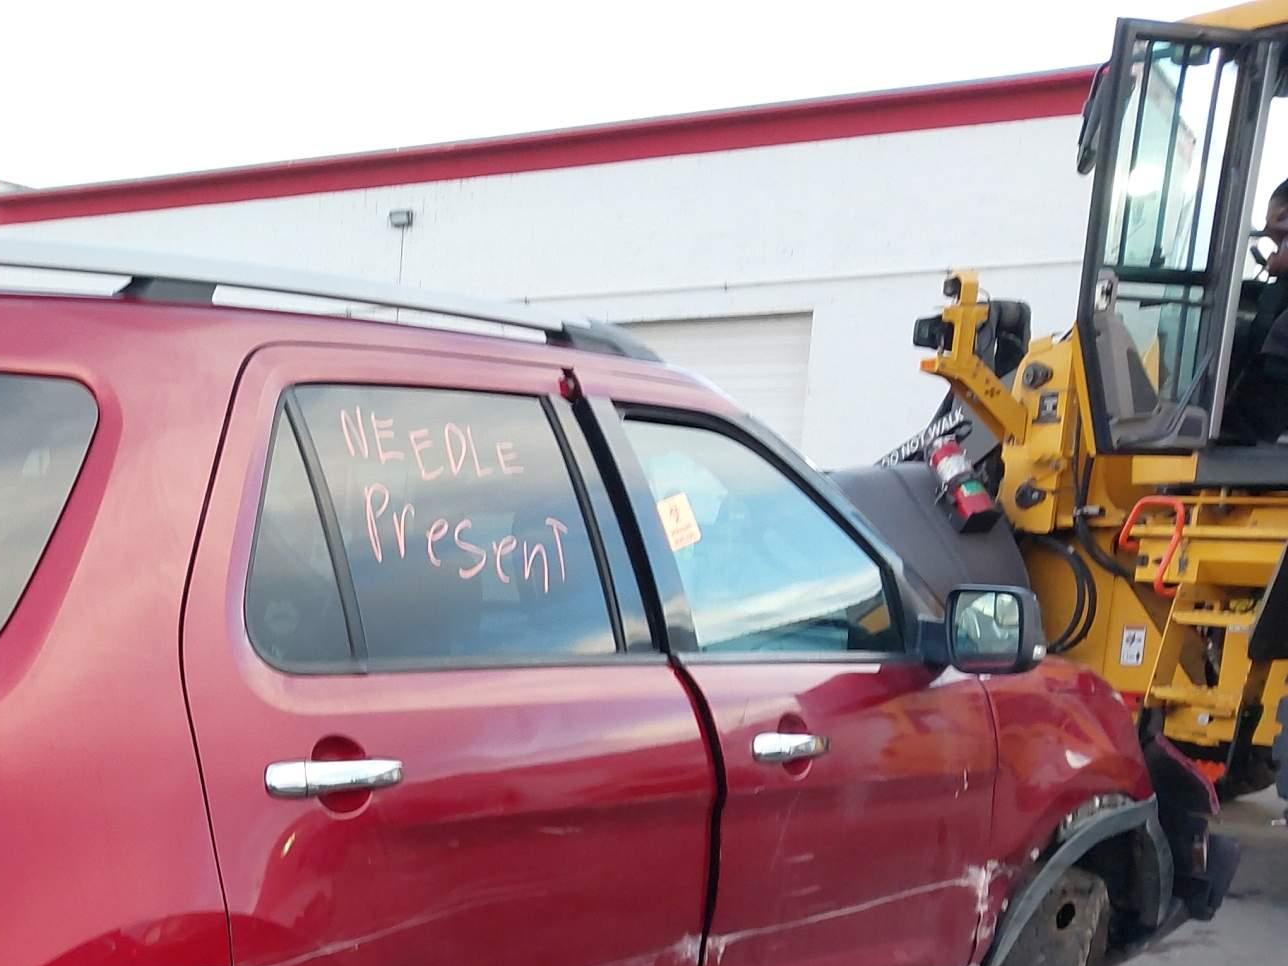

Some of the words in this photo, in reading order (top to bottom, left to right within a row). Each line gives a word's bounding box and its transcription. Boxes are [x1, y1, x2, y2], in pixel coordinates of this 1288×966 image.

[340, 404, 524, 480] NEEDLE
[901, 432, 926, 459] NOT
[927, 406, 964, 439] WALK
